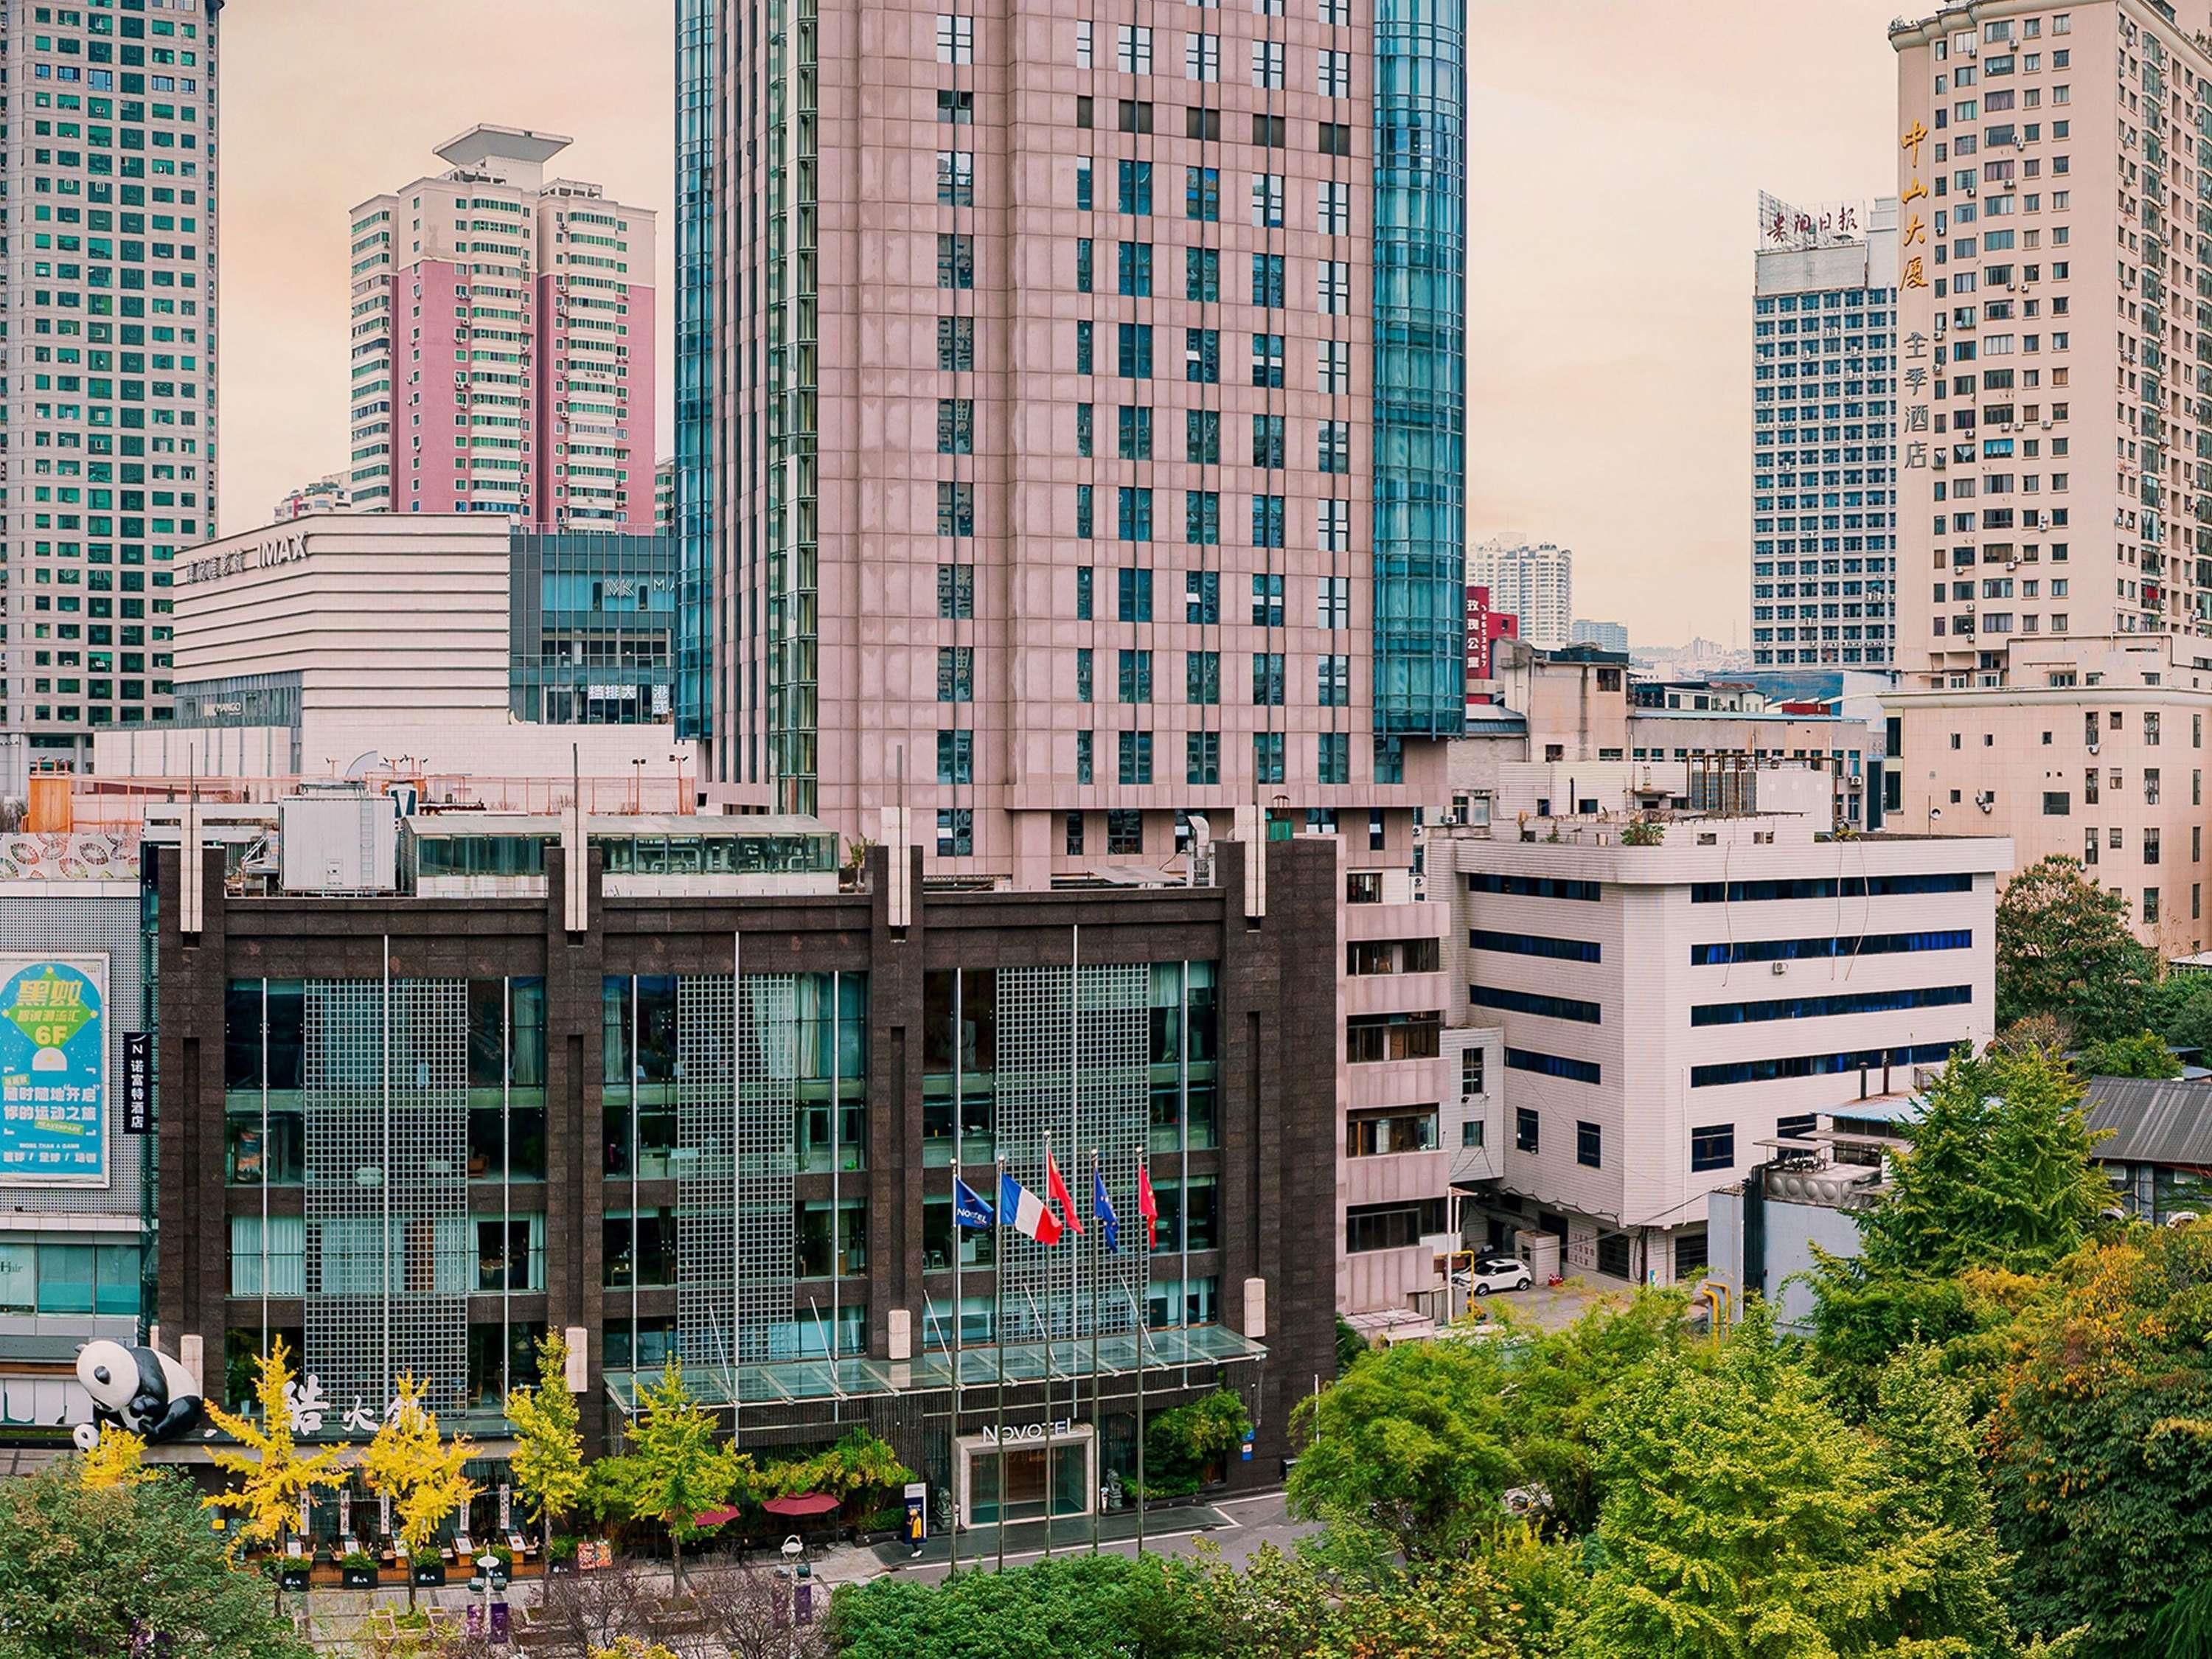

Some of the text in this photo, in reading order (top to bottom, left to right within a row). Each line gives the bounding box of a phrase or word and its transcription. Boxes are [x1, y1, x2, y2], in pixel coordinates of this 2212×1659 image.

[1767, 206, 1858, 242] 贵阳日报
[1900, 119, 1928, 291] 中山大厦
[1905, 332, 1928, 468] 全季酒店
[257, 532, 307, 568] IMAX
[35, 1026, 67, 1045] 6F
[131, 1060, 144, 1128] 诺富特酒店
